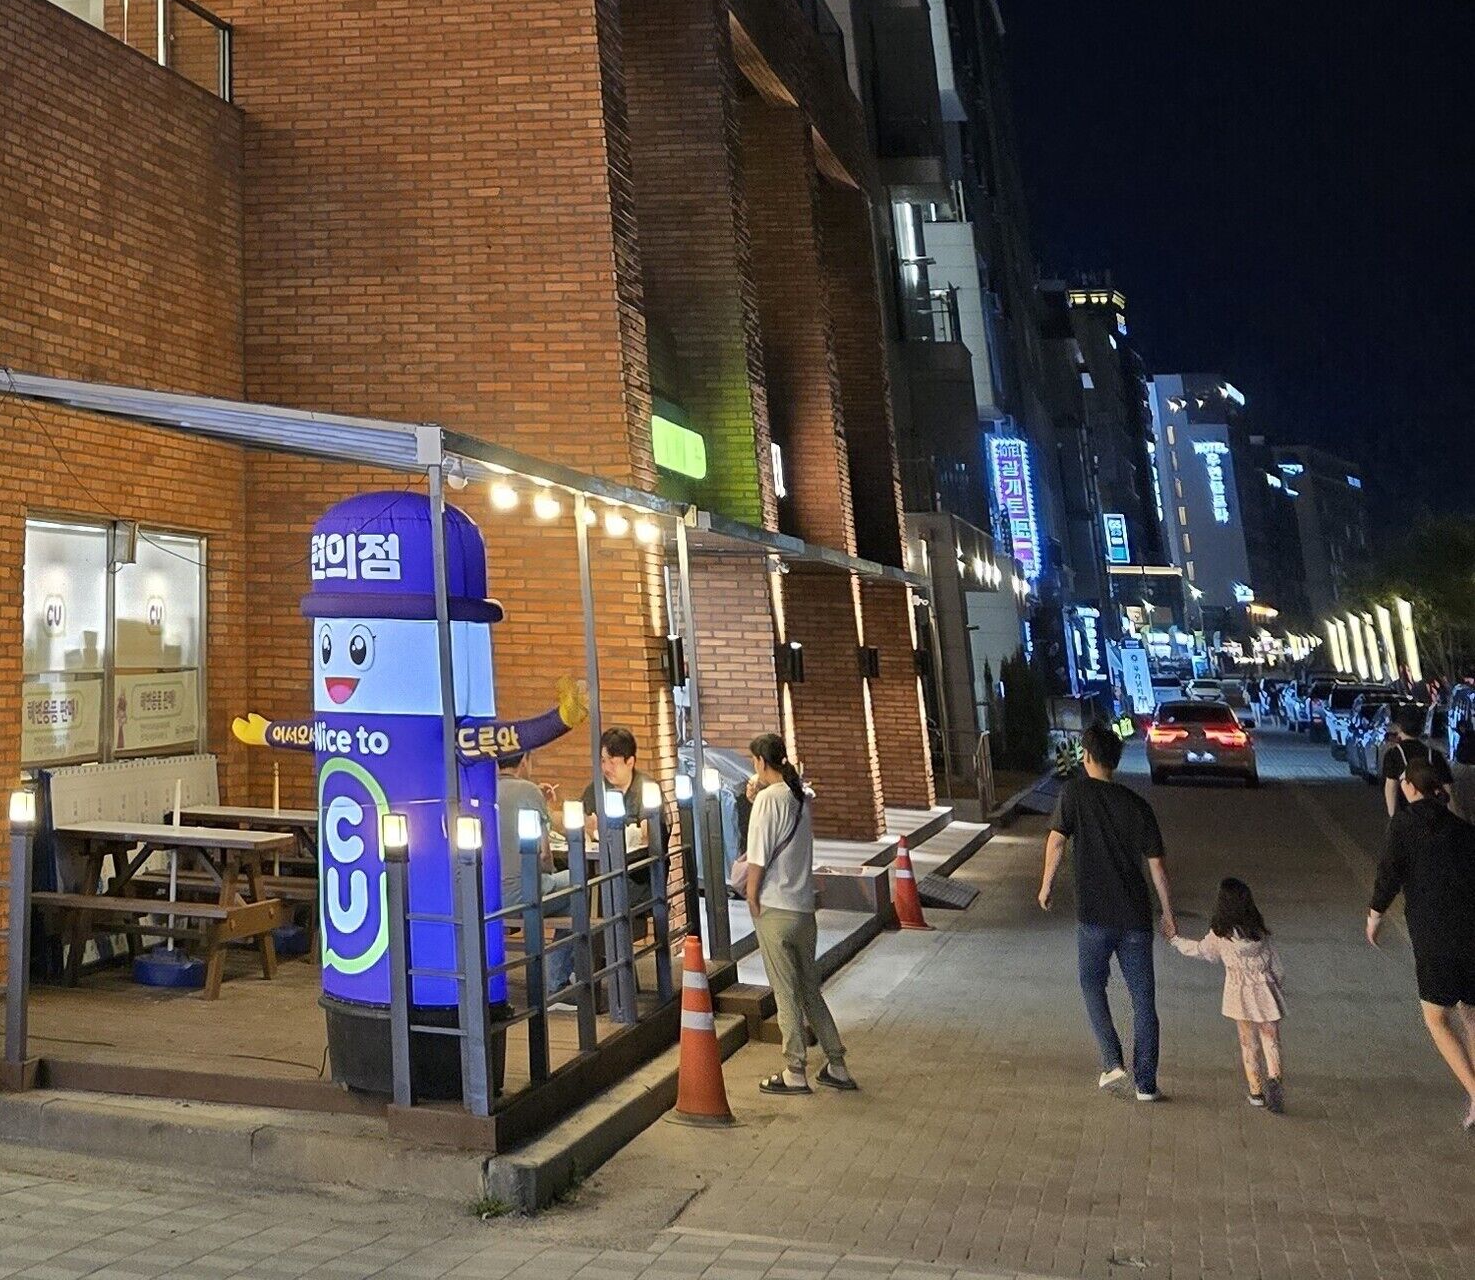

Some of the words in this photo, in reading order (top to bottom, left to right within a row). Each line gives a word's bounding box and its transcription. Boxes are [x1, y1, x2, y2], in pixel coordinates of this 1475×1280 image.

[311, 533, 401, 580] 편의점
[47, 605, 62, 627] CU
[149, 605, 163, 626] CU
[314, 721, 352, 754] Nice
[356, 725, 390, 755] to
